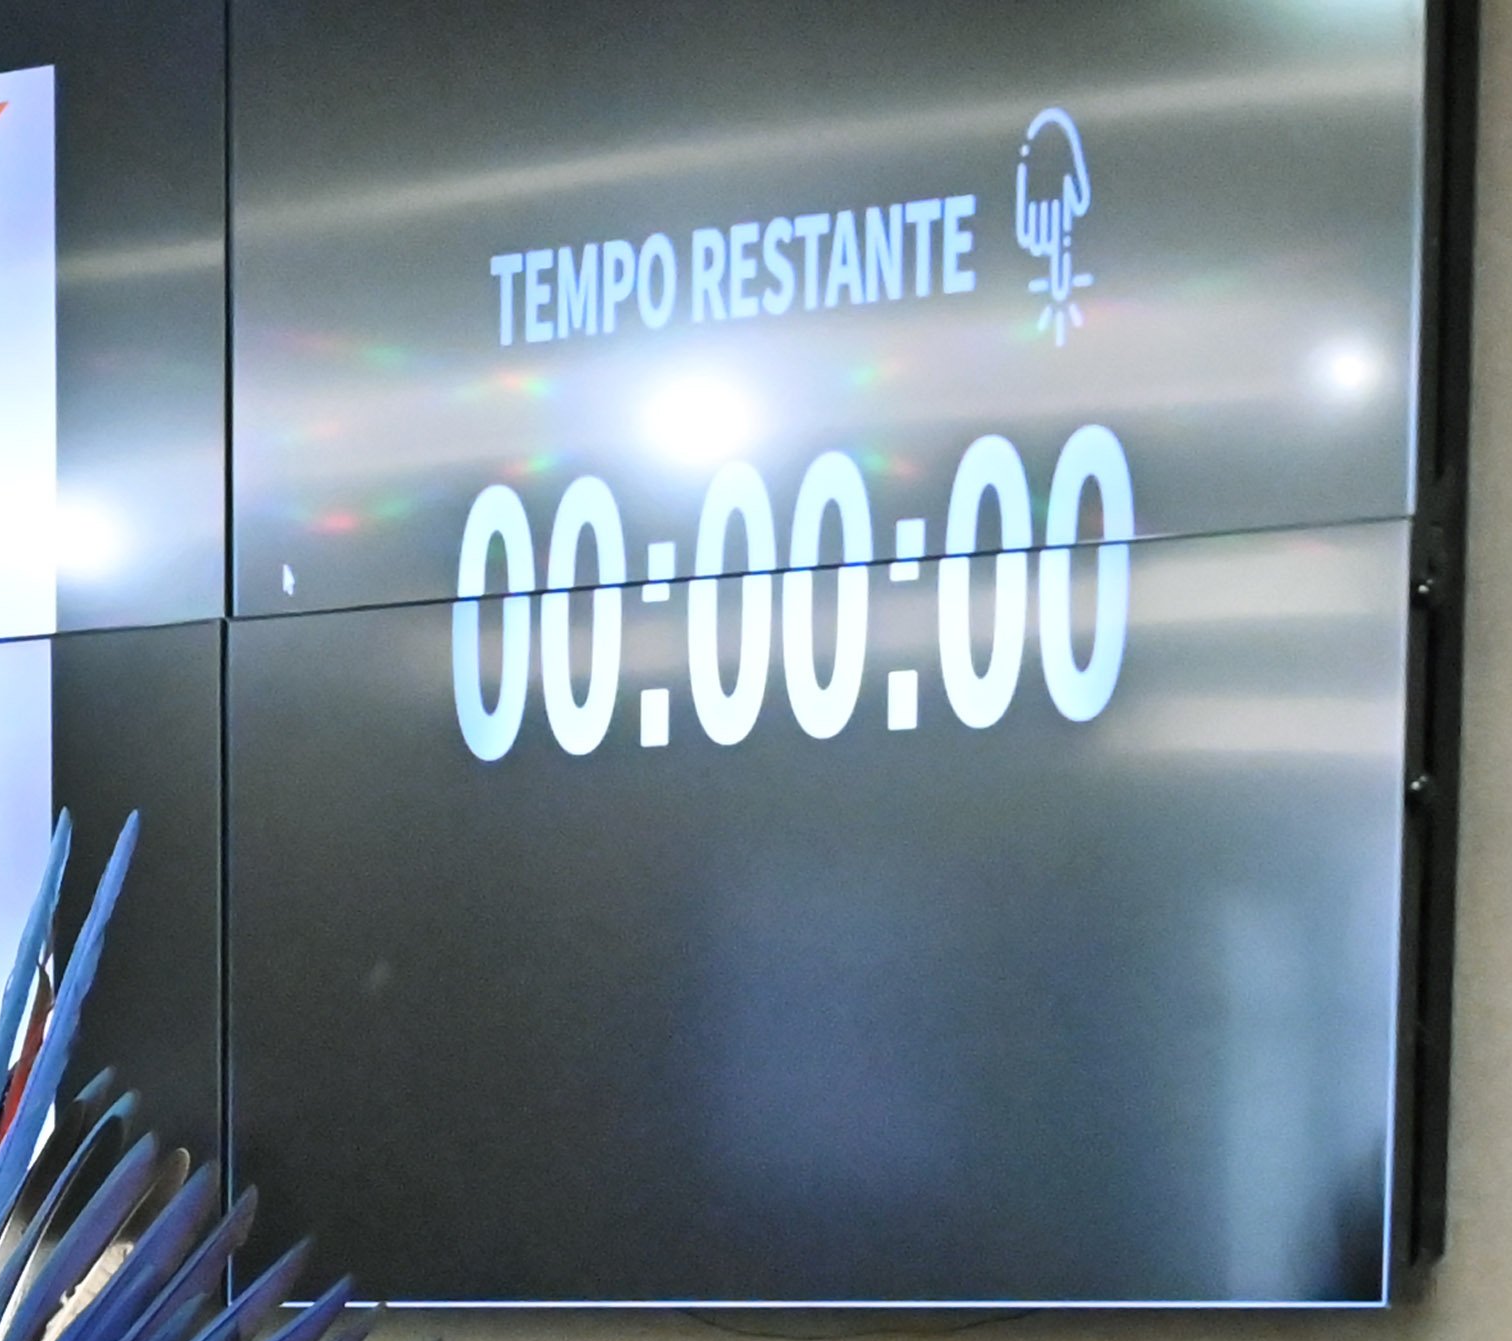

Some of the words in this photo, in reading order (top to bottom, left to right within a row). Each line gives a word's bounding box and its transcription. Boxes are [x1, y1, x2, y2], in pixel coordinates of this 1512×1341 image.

[489, 232, 677, 347] TEMPO
[690, 194, 977, 324] RESTANTE
[451, 424, 1136, 762] 00:00:00
